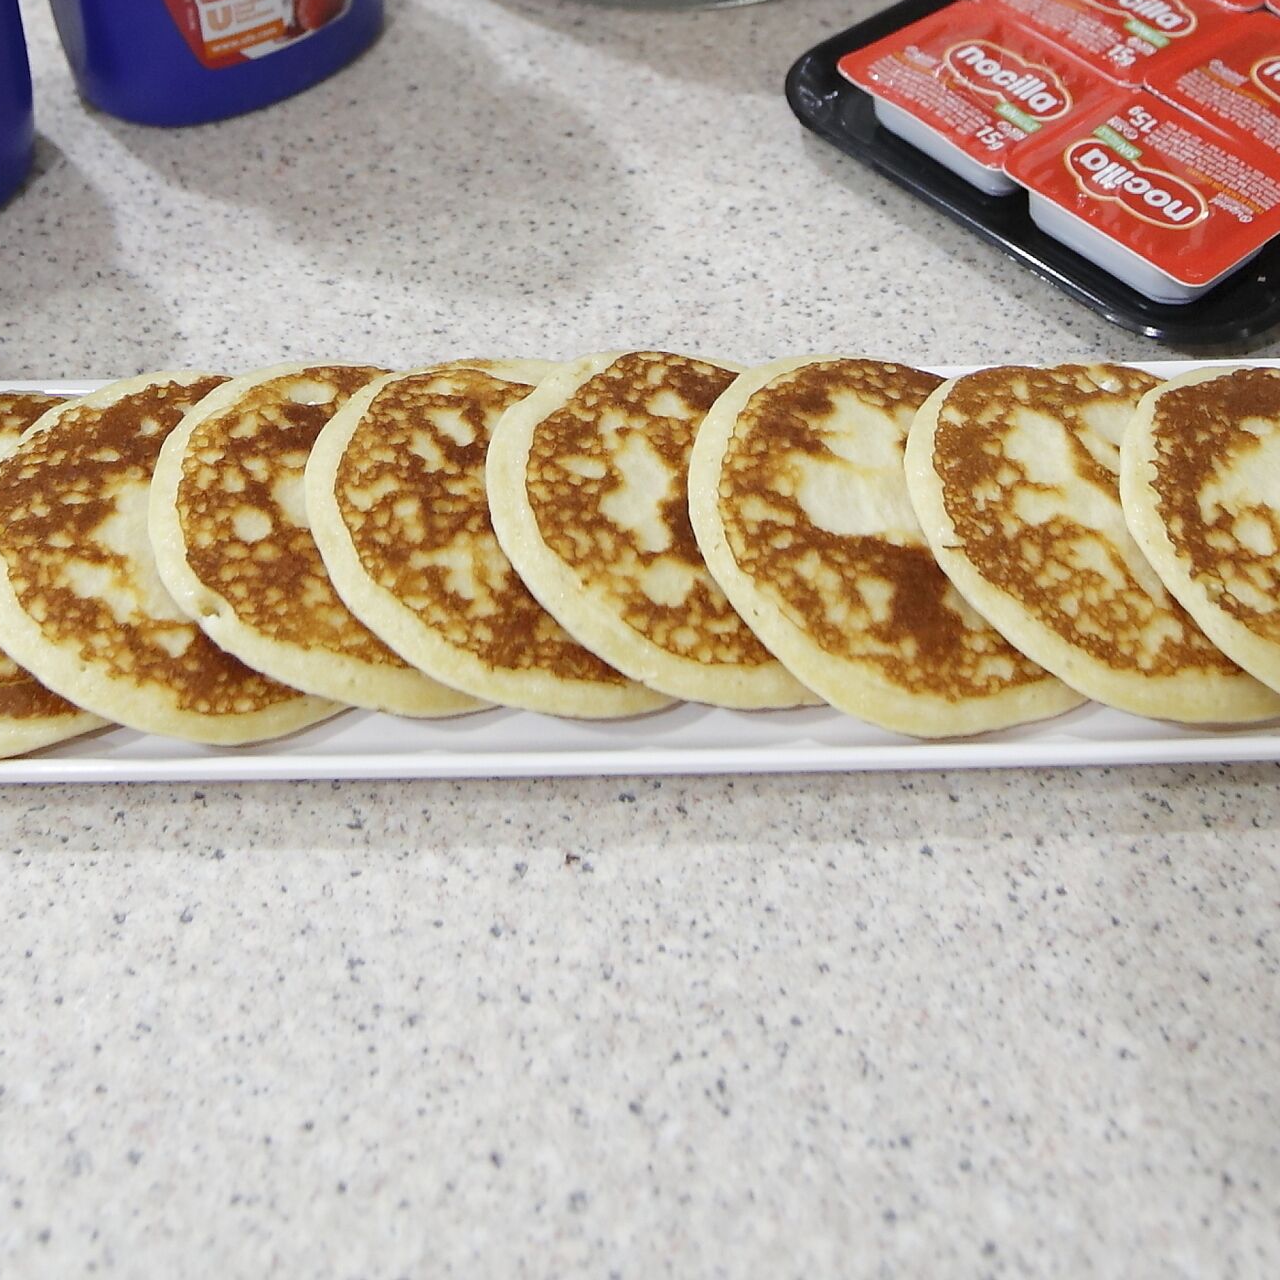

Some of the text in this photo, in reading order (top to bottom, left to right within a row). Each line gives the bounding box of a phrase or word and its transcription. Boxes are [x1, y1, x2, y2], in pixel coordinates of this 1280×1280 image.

[955, 44, 1059, 113] nocilla
[976, 124, 1006, 152] 15g
[1127, 104, 1158, 134] 15g
[1078, 147, 1195, 222] nocilla
